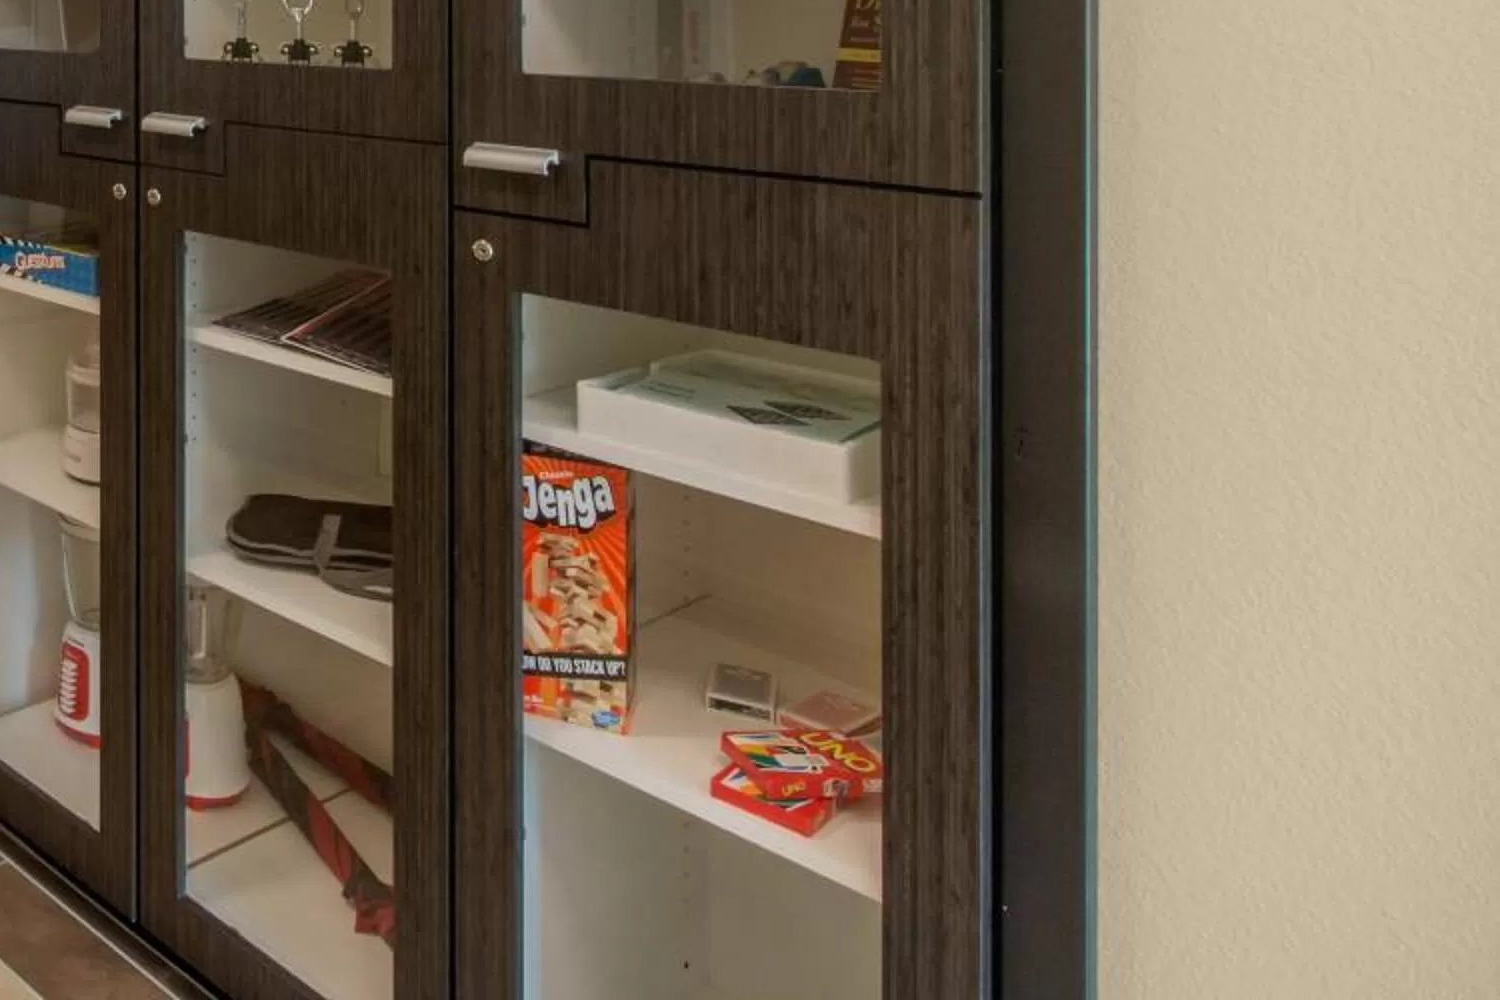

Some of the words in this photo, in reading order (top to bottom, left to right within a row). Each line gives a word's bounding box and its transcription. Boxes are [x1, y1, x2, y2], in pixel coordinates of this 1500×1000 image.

[522, 474, 615, 530] Jenga
[573, 658, 606, 676] STACK
[798, 732, 877, 773] UNO
